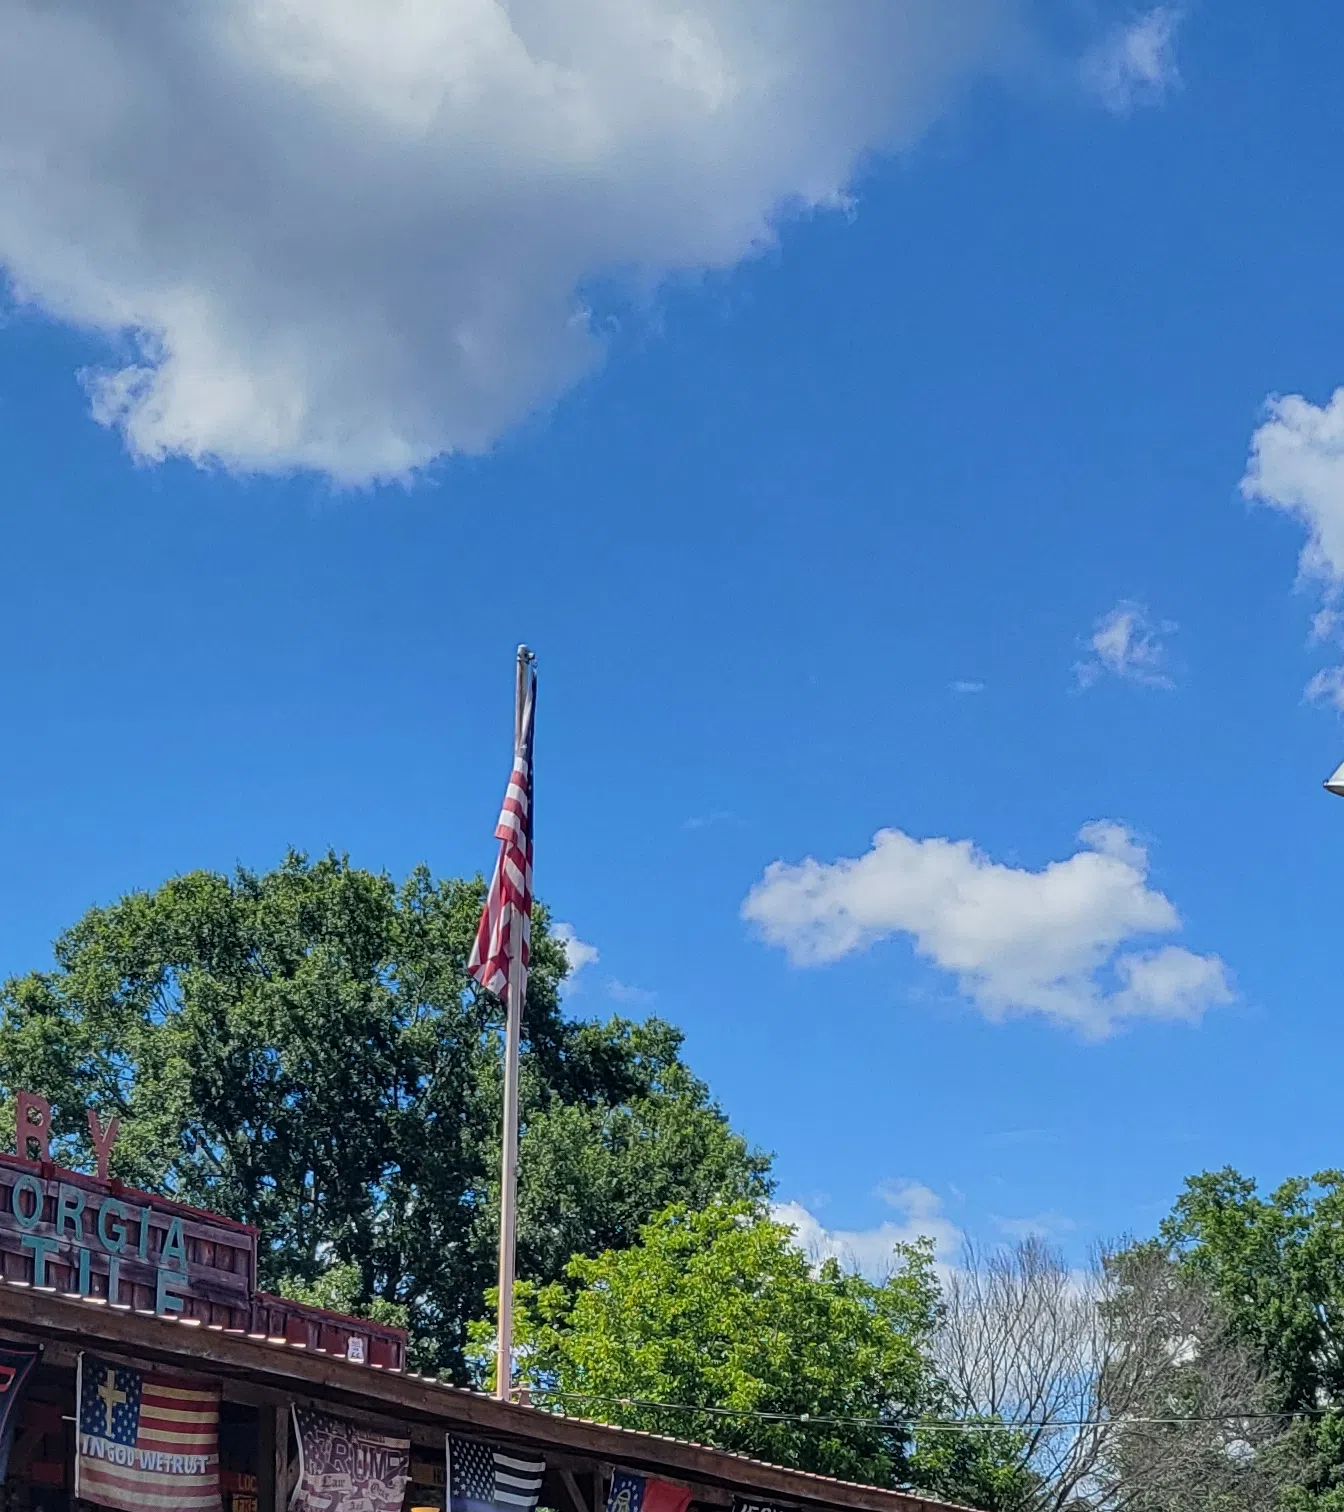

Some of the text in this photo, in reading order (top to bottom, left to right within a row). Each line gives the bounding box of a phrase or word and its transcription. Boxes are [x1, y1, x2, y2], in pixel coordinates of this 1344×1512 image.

[81, 1436, 209, 1475] IN GOD WE TRUST
